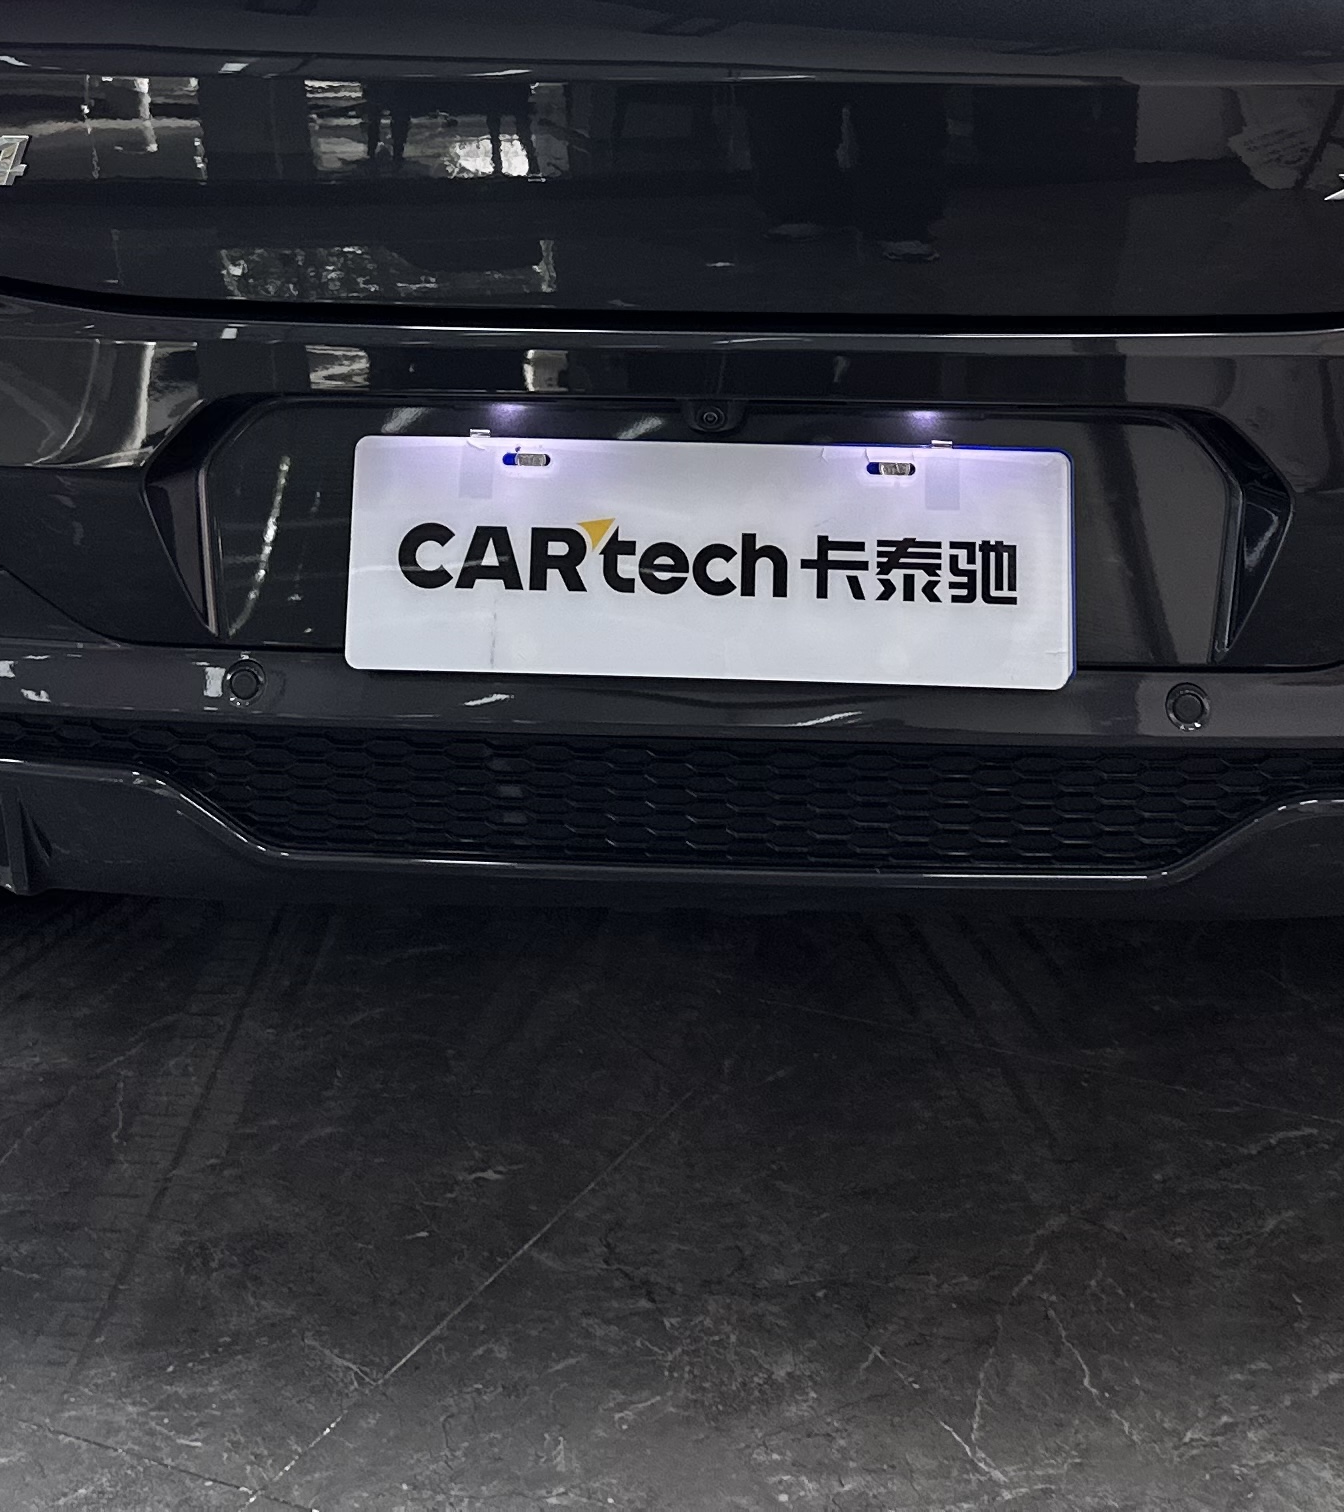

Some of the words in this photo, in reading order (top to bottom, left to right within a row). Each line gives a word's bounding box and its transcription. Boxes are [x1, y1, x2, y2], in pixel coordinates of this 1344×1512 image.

[397, 517, 788, 598] CARtech
[800, 534, 1018, 606] 卡泰驰
